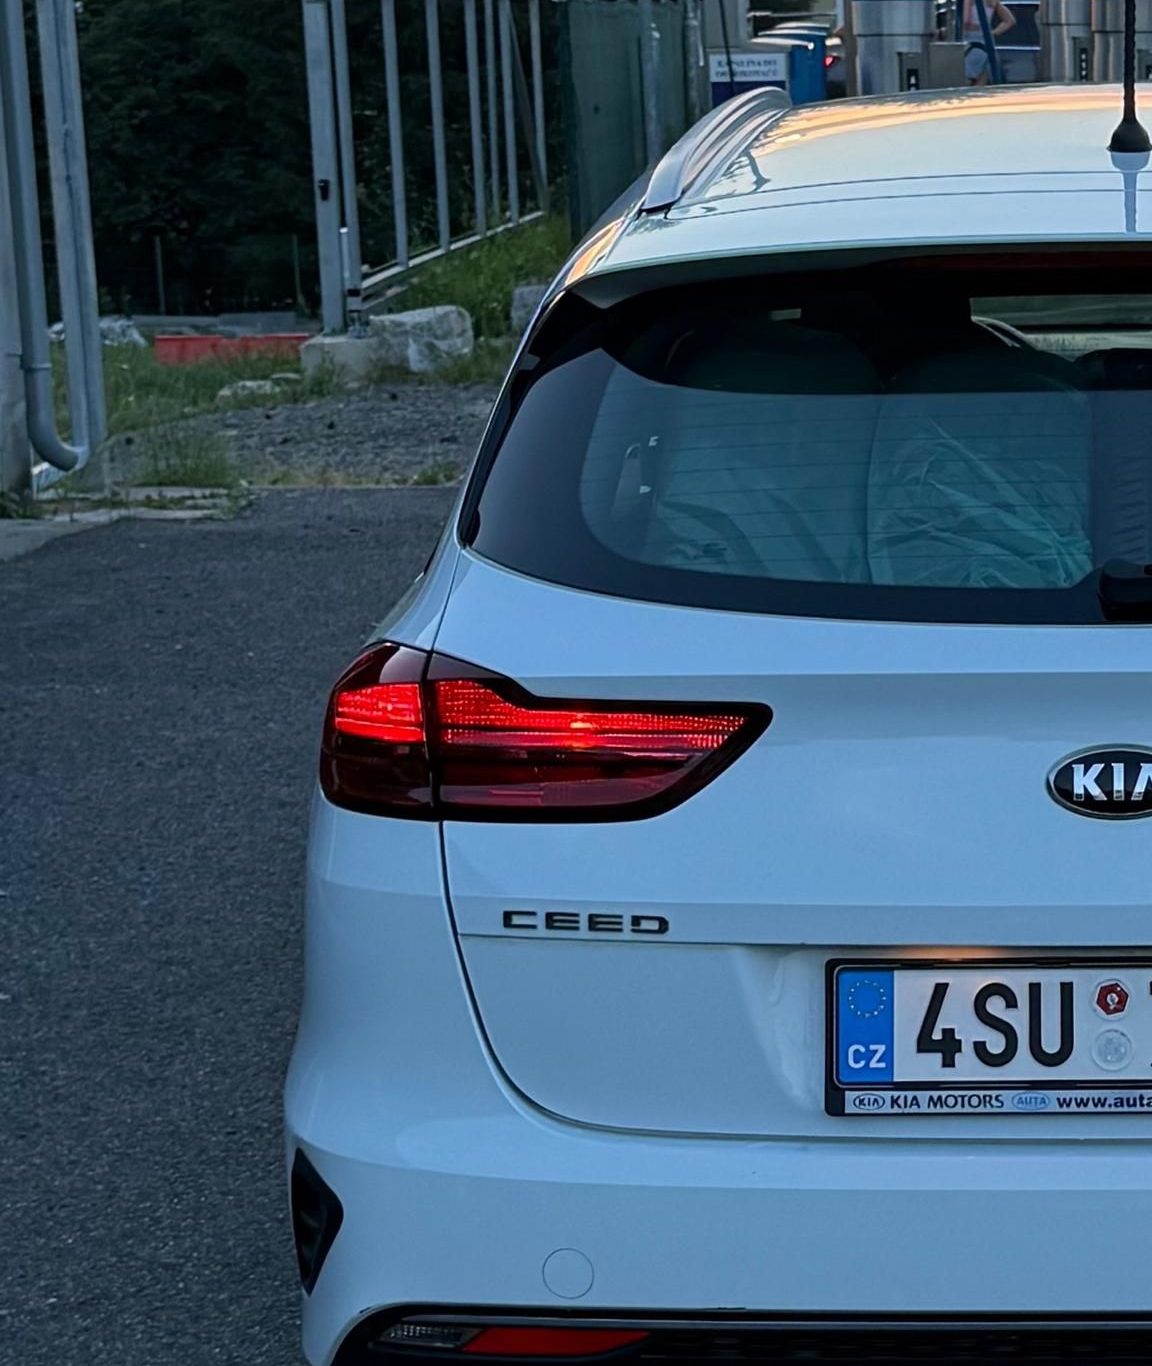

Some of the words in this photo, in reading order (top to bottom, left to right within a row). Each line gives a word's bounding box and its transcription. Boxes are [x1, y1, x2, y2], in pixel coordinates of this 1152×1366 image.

[502, 910, 670, 935] CEED
[916, 981, 1075, 1068] 4SU
[847, 1044, 887, 1069] CZ
[858, 1094, 882, 1108] KIA
[890, 1095, 921, 1109] KIA
[927, 1093, 1005, 1109] MOTORS
[1016, 1094, 1047, 1106] AUTA
